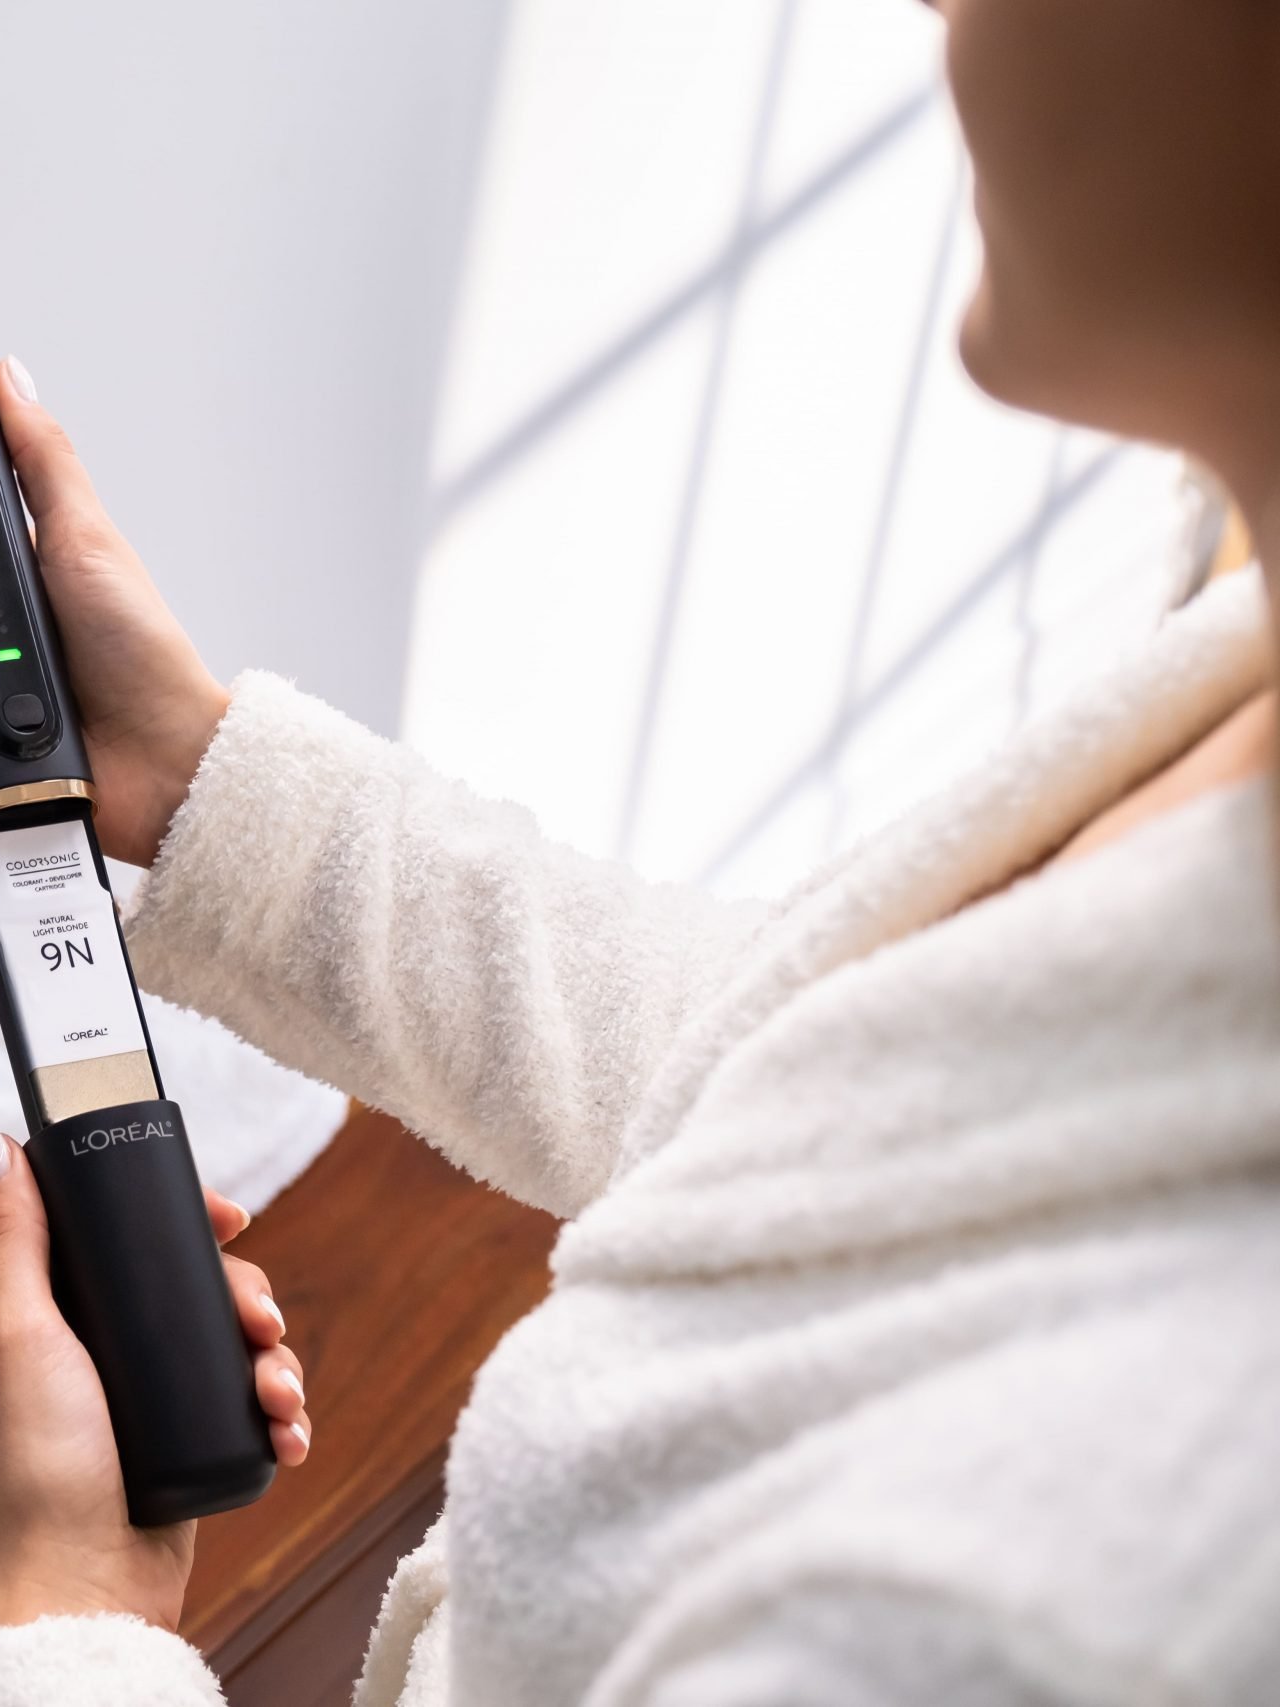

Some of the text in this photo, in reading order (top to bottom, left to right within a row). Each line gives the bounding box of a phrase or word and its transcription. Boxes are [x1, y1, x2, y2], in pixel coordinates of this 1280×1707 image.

[6, 852, 80, 871] COLORSONIC
[13, 878, 43, 888] COLORANT
[49, 872, 82, 883] DEVELOPER
[35, 883, 65, 892] CARTRIDGE
[39, 914, 75, 926] NATURAL
[33, 922, 89, 938] LIGHT BLONDE
[40, 937, 94, 972] 9N
